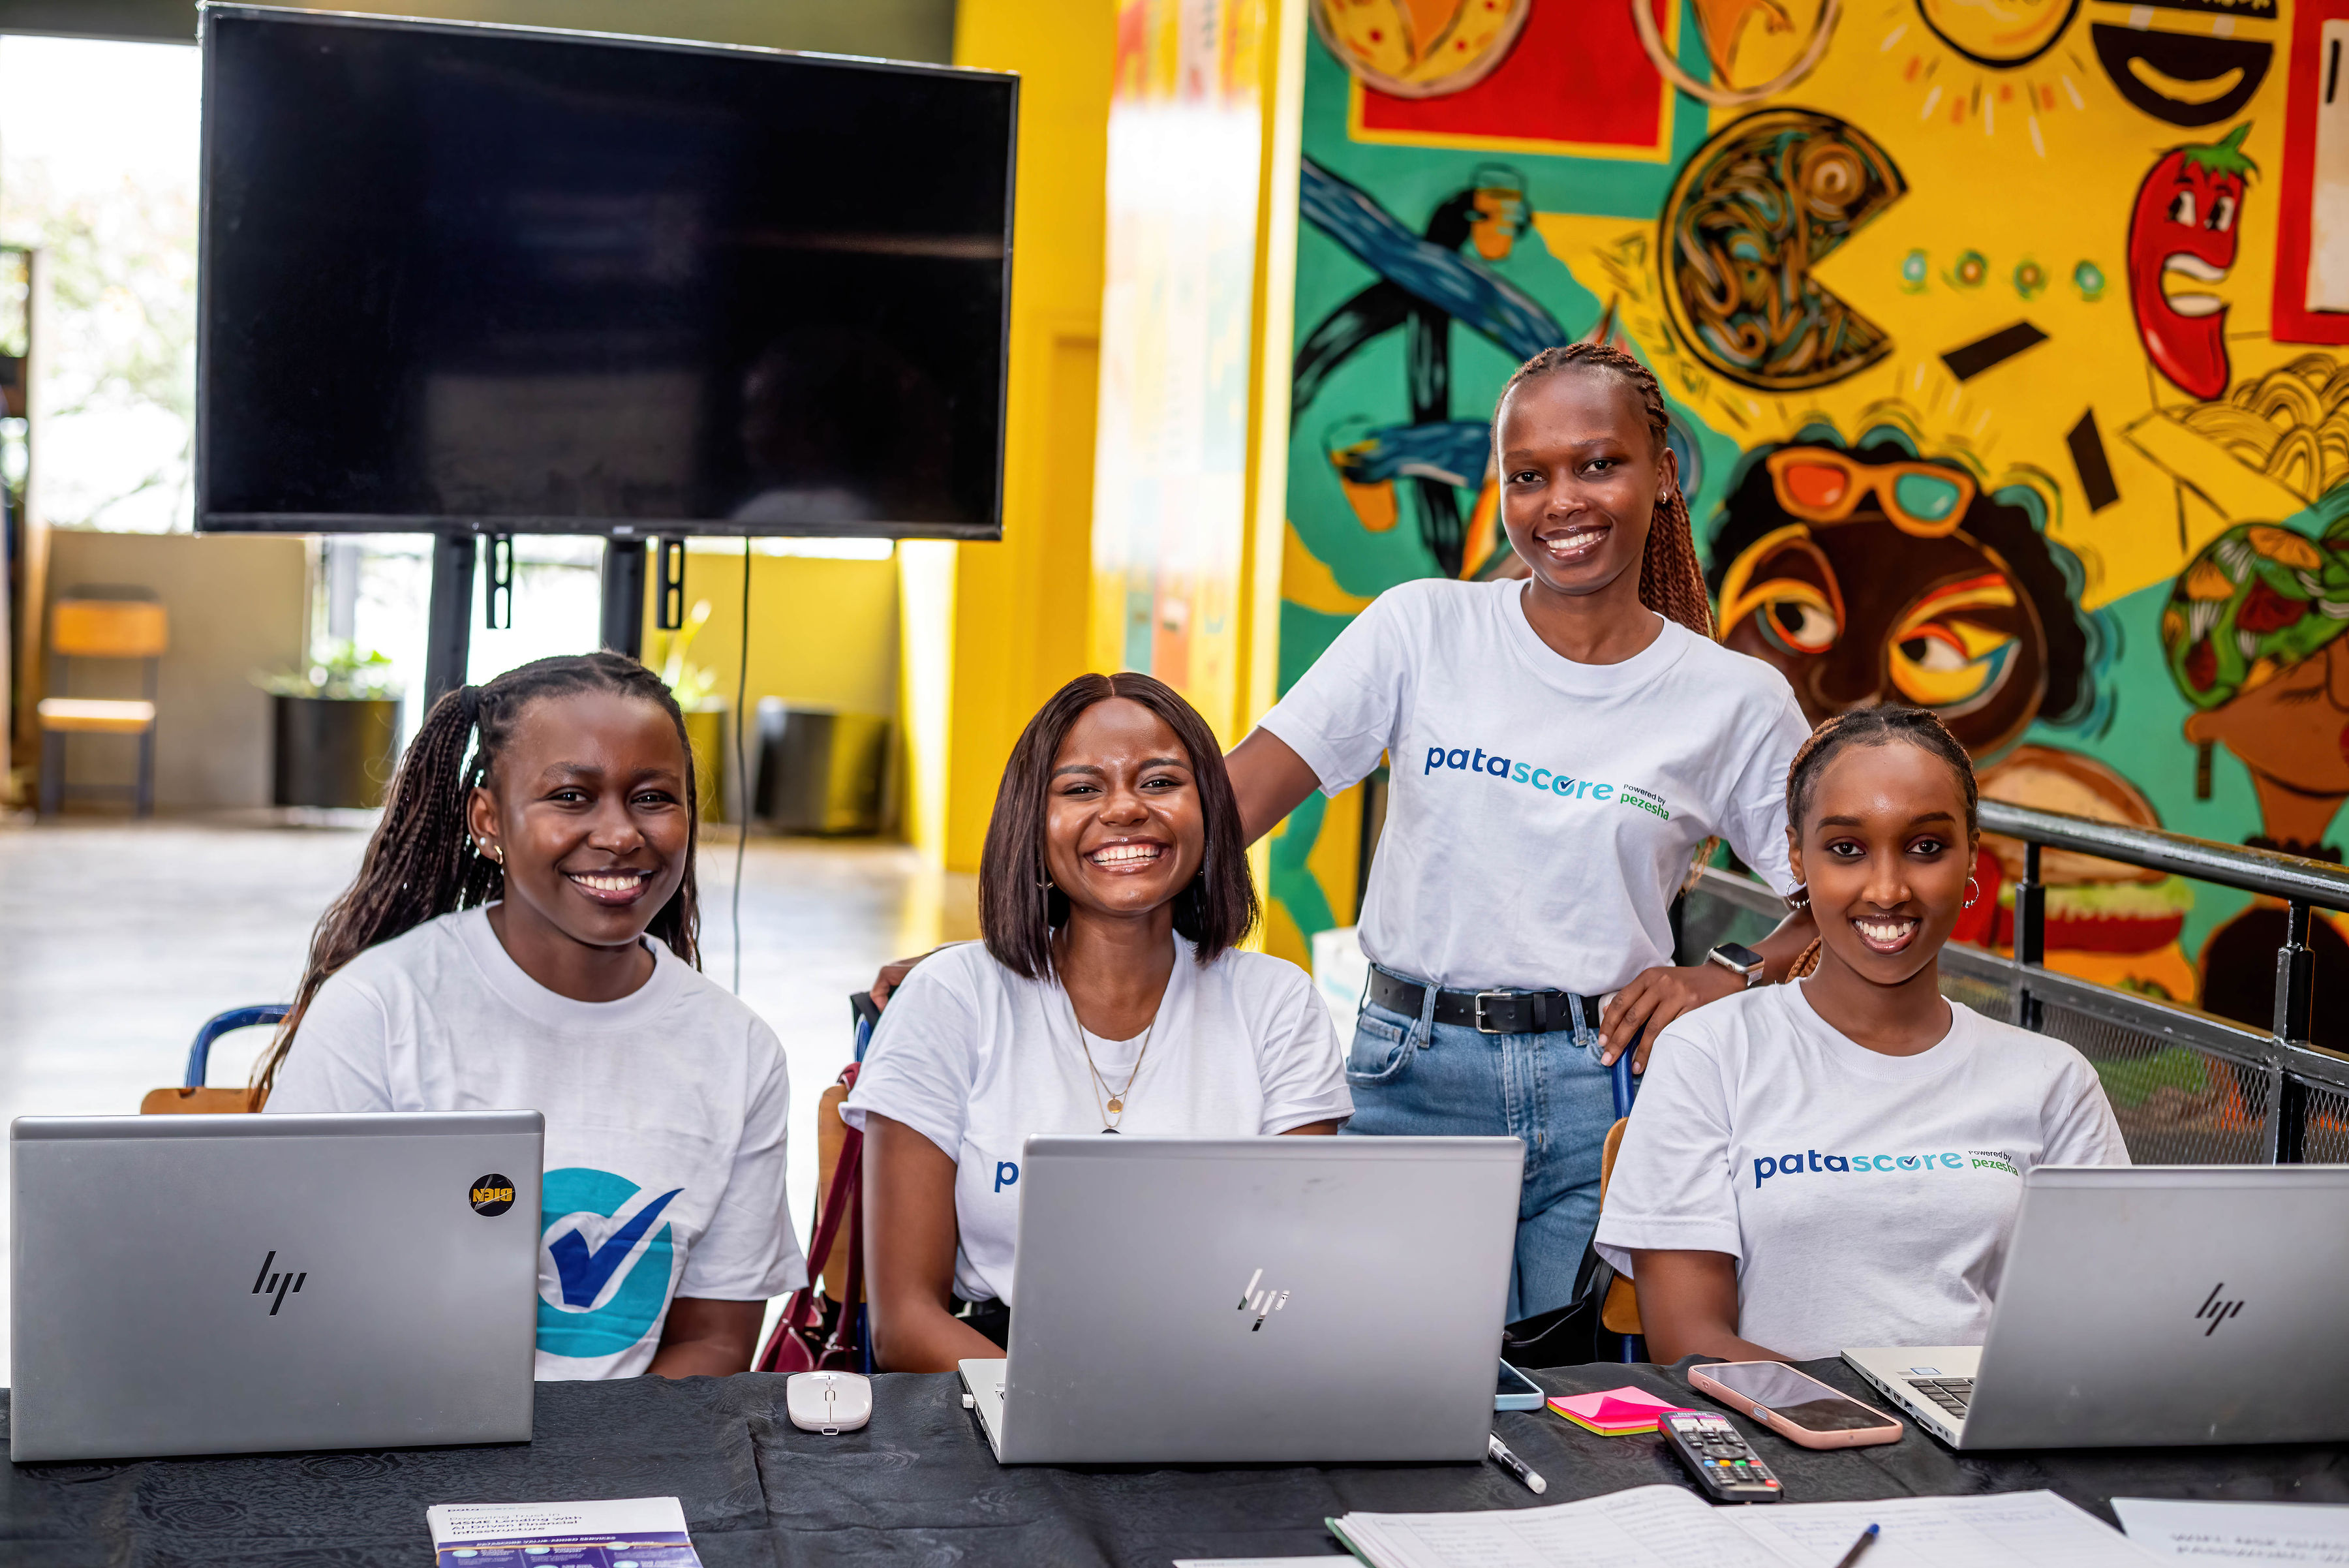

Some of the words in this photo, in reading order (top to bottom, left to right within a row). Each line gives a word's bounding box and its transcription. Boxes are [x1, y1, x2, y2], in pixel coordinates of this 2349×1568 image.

[1424, 746, 1614, 801] patascore
[1620, 793, 1670, 821] pezesha
[1657, 792, 1666, 806] by
[1971, 1158, 2019, 1176] pezesha
[2003, 1151, 2012, 1163] by
[994, 1161, 1022, 1193] p
[1754, 1149, 1963, 1189] patascore
[472, 1188, 513, 1202] BIEN
